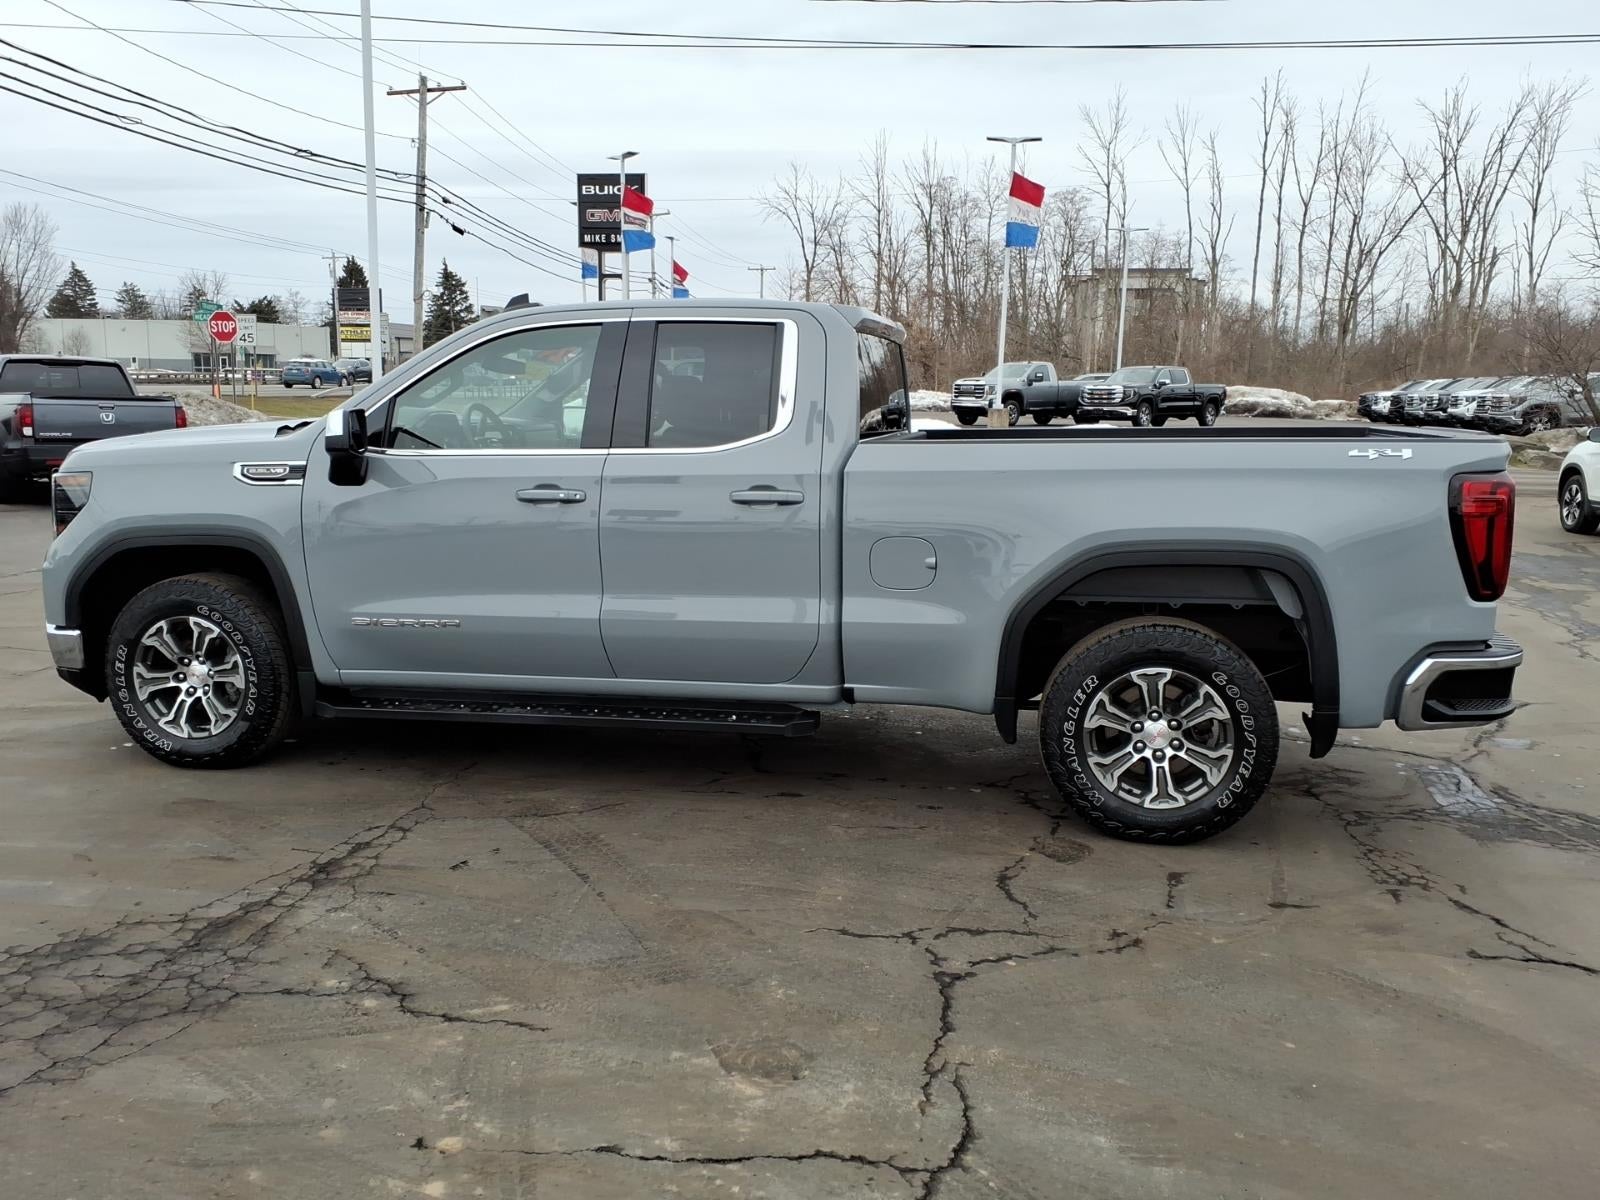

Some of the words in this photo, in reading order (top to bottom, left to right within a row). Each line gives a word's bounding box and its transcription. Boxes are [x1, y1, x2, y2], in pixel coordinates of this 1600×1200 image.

[582, 185, 639, 195] BUIC
[586, 209, 621, 222] GM
[584, 234, 606, 243] MIKE
[210, 320, 236, 333] STOP
[239, 333, 254, 343] 45
[351, 617, 461, 628] SIERRA
[196, 604, 258, 716] GOODYEAR
[115, 643, 174, 752] WRANGLER
[1063, 674, 1105, 807] WRANGLER
[1211, 671, 1257, 809] GOODYEAR
